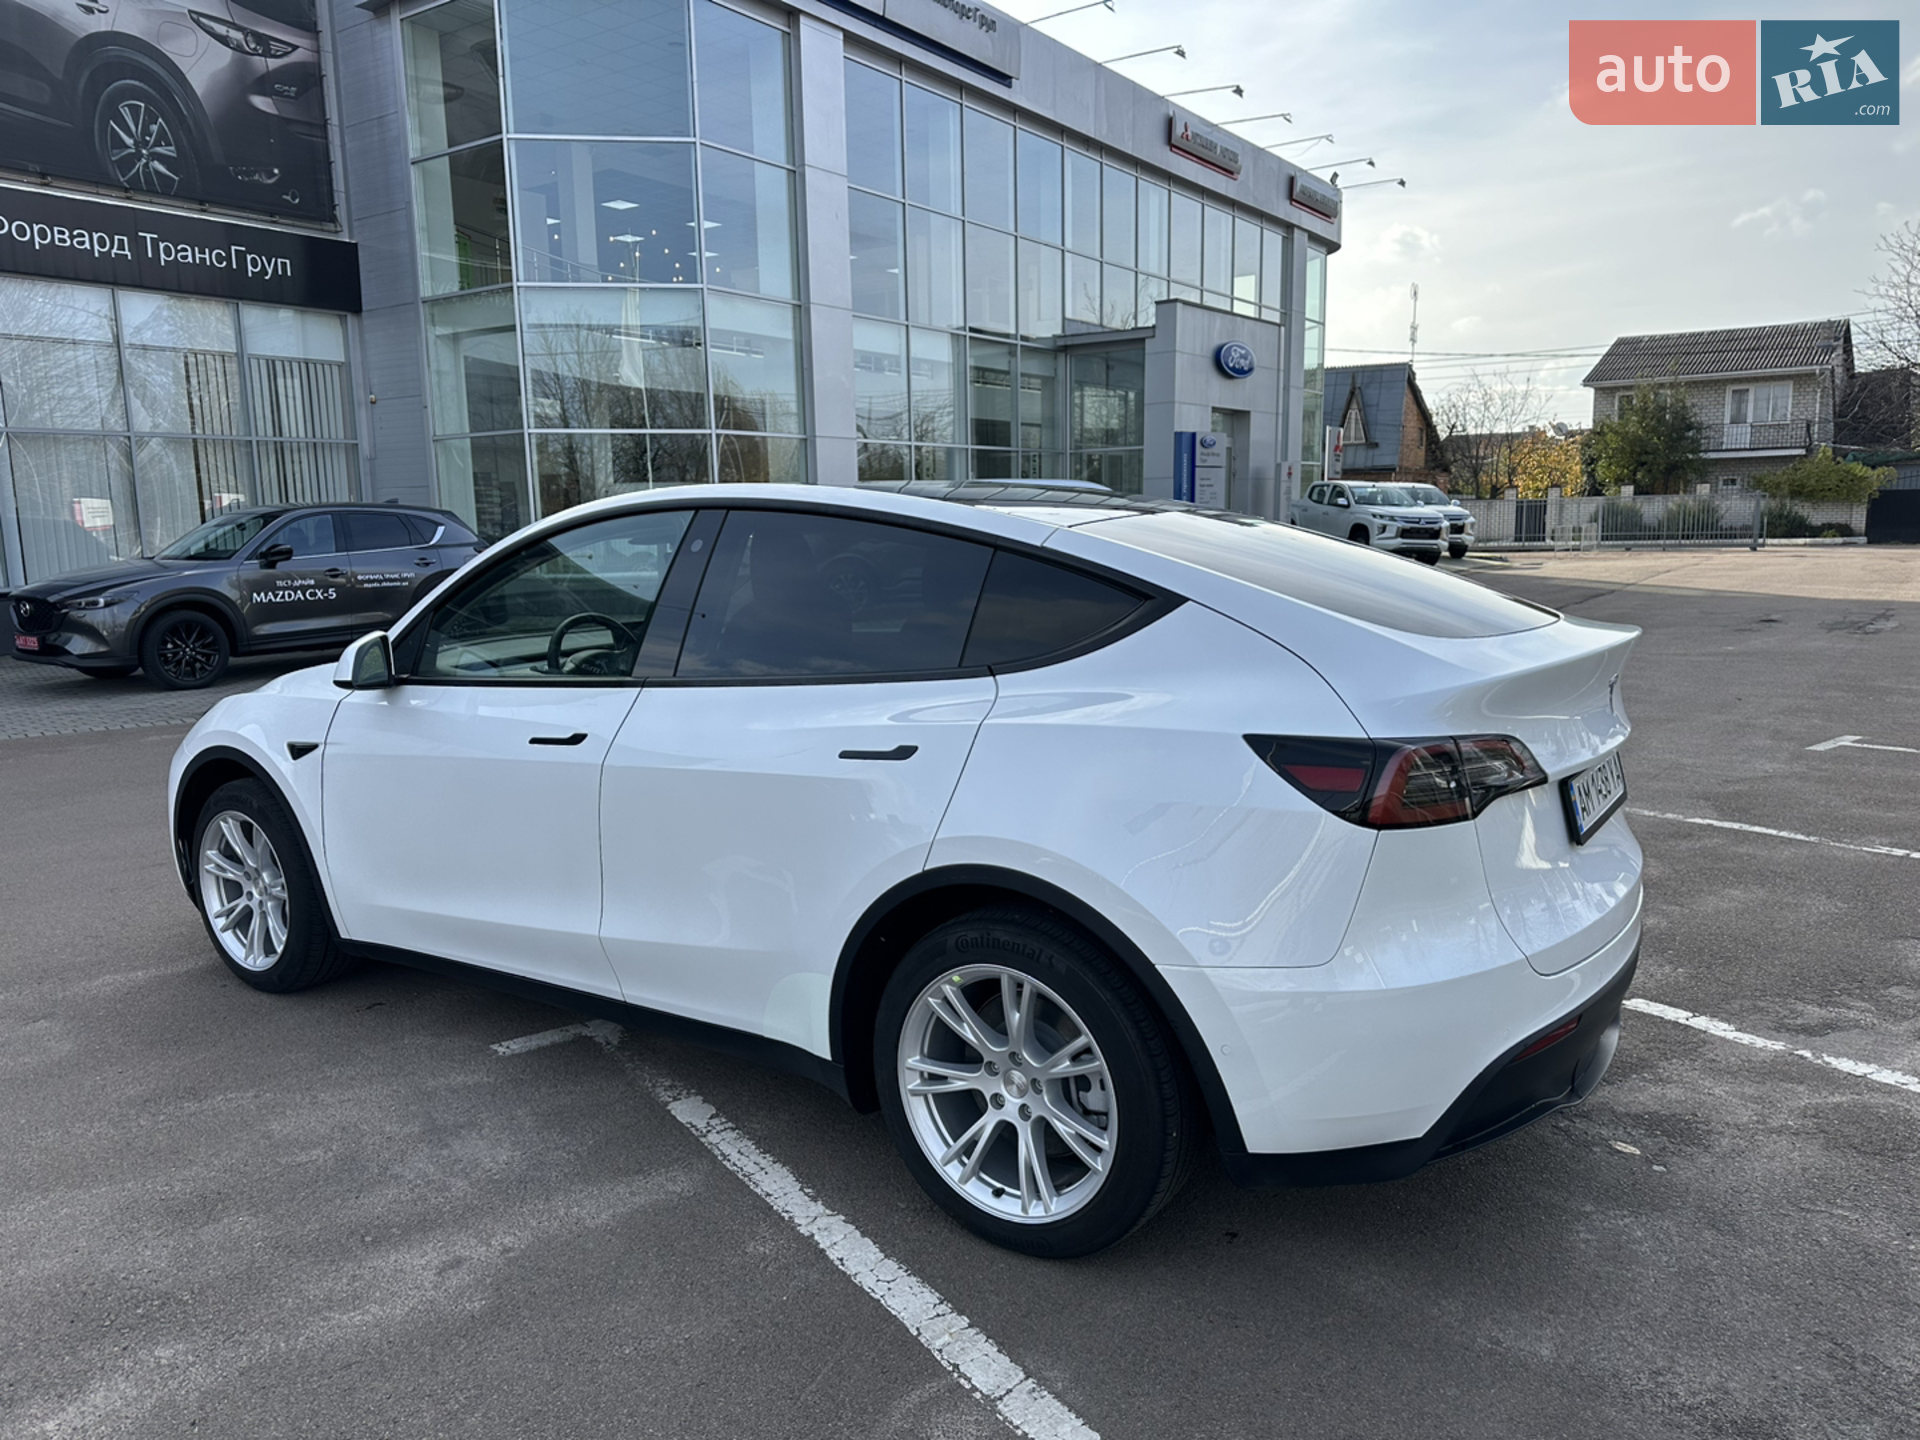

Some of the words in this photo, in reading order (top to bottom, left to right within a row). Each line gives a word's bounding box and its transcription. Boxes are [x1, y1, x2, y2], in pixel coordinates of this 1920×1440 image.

[252, 590, 305, 604] MAZDA
[305, 588, 337, 600] CX-5
[954, 932, 1044, 963] Continental
